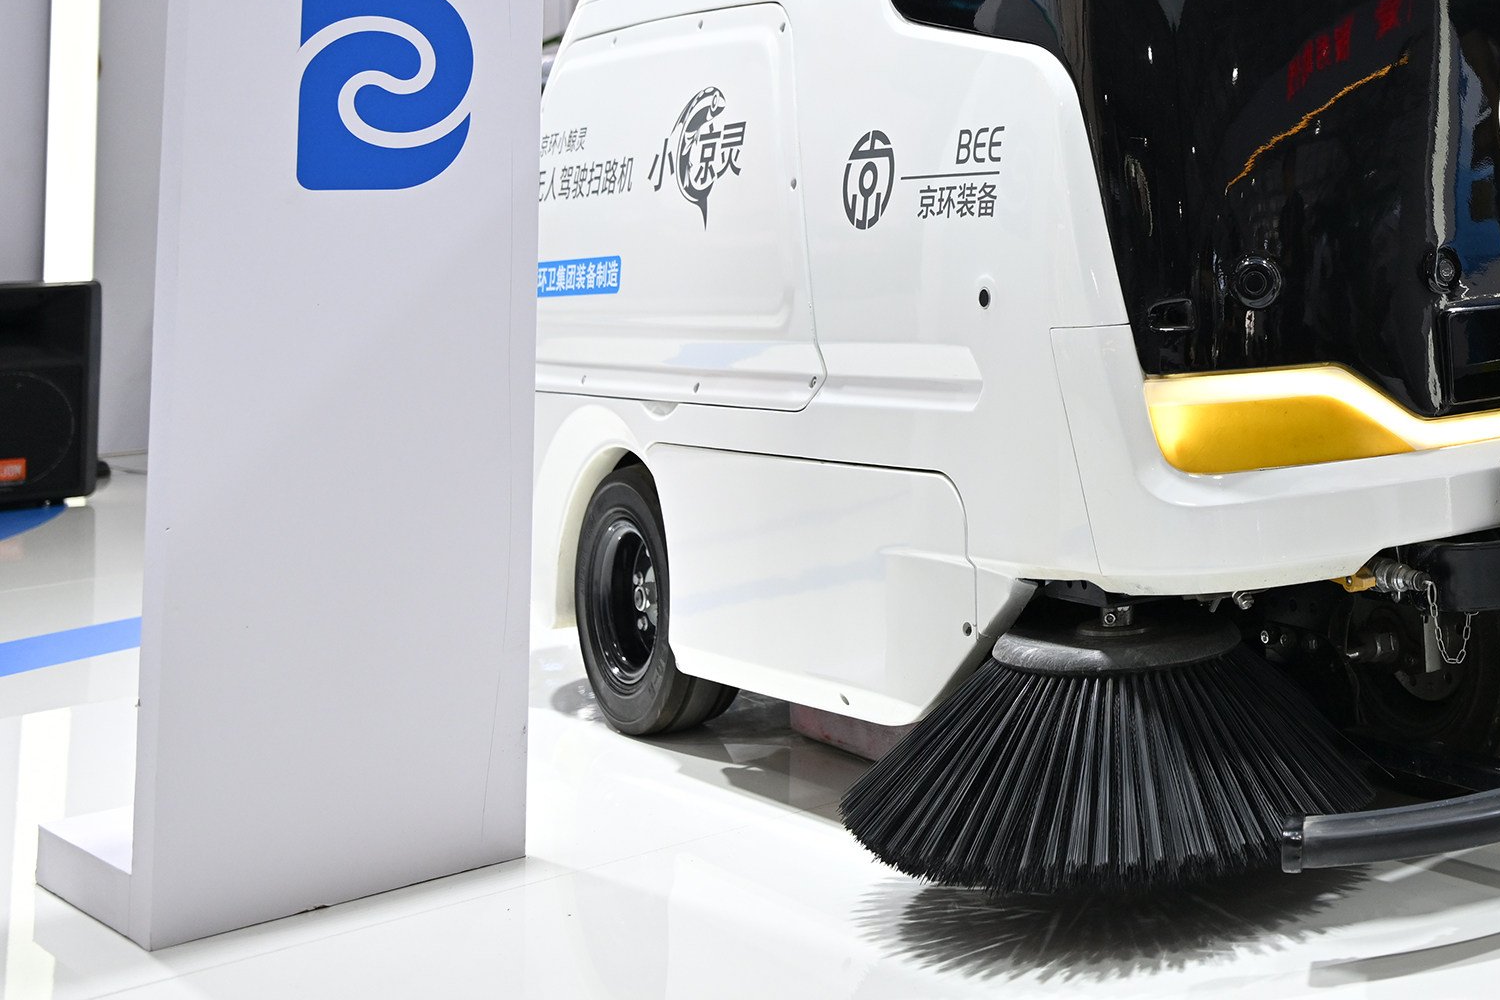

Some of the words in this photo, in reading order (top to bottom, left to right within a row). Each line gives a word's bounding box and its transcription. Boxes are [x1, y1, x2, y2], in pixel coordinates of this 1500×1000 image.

[540, 127, 587, 158] 京环小鲸灵
[955, 126, 1005, 165] BEE
[917, 182, 998, 219] 京环装备
